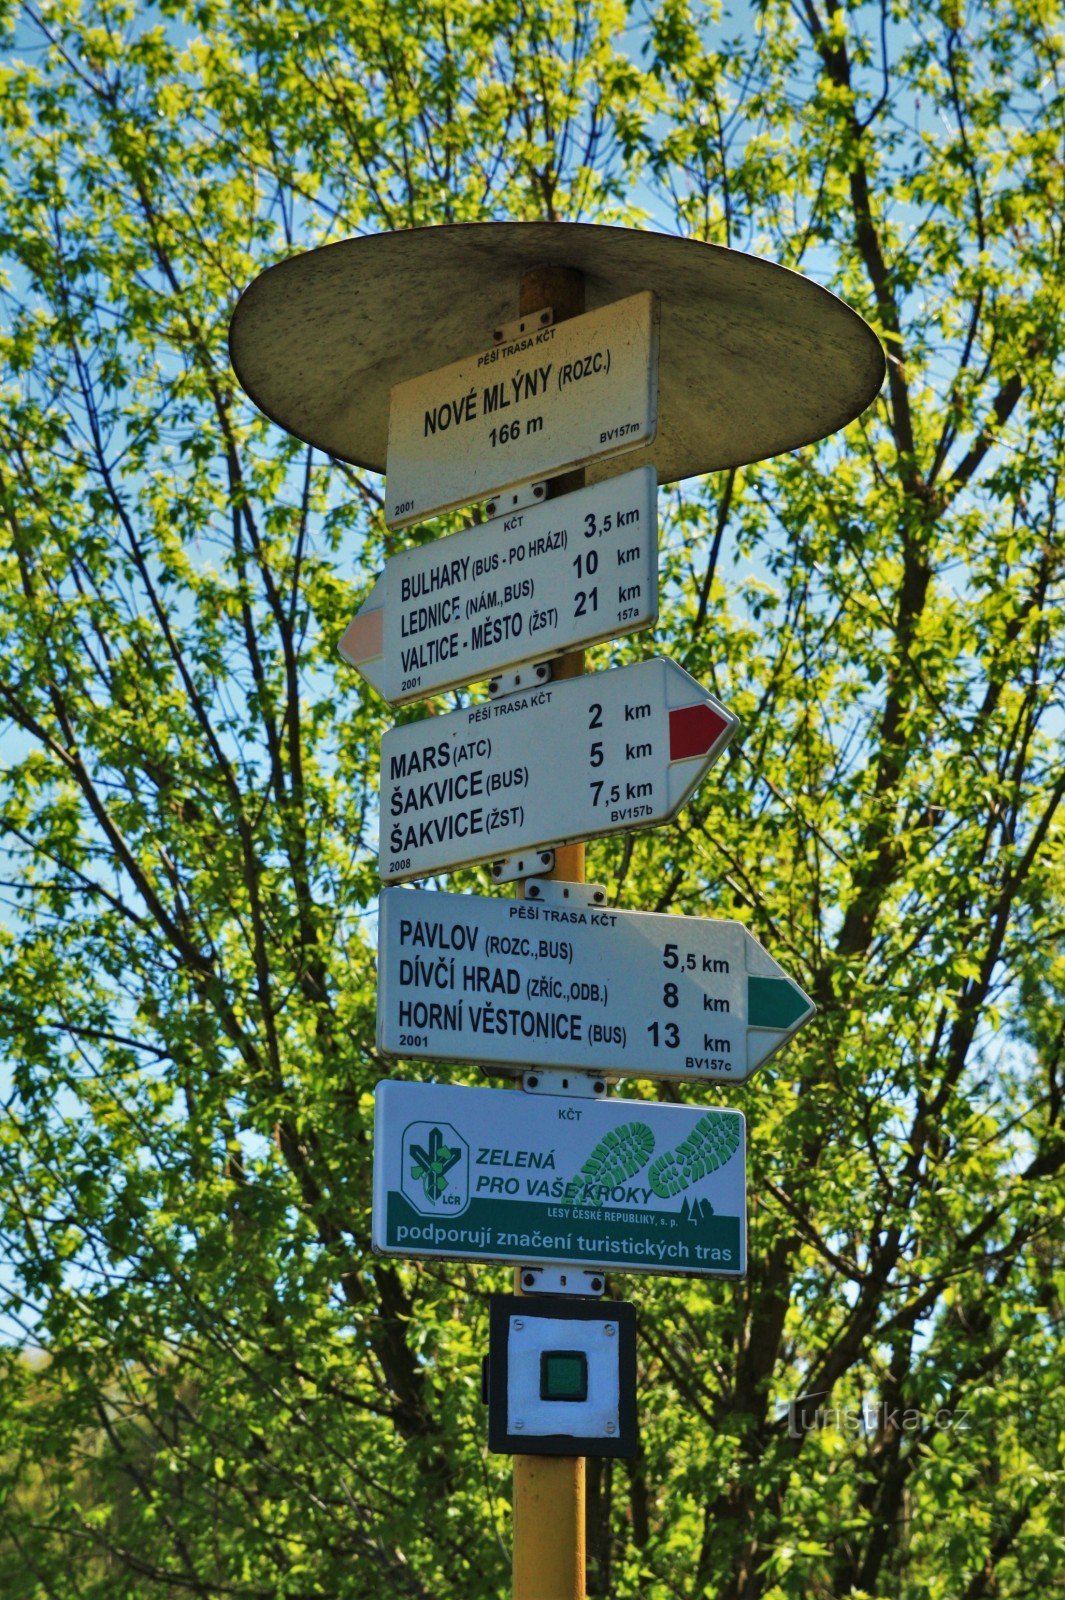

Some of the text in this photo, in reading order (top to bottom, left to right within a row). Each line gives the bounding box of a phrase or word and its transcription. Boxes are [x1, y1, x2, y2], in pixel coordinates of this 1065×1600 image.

[478, 328, 556, 367] PĚŠÍ TRASA KČT
[424, 349, 611, 437] NOVÉ MLÝNY (ROZC.)
[489, 416, 543, 447] 166 m
[600, 422, 640, 443] BV157m
[394, 500, 414, 516] 2001
[504, 516, 524, 533] KČT
[401, 556, 470, 602] BULHARY
[472, 553, 499, 579] (BUS
[509, 544, 526, 565] PO
[529, 529, 568, 559] HRÁZI)
[584, 513, 612, 538] 3,5
[616, 508, 640, 528] km
[573, 550, 598, 579] 10
[617, 546, 640, 566] km
[401, 633, 459, 673] VALTICE
[472, 612, 522, 650] MĚSTO
[528, 608, 558, 636] (ŽST)
[574, 587, 598, 618] 21
[618, 584, 641, 603] km
[617, 607, 639, 622] 157a
[401, 676, 421, 692] 2001
[468, 692, 553, 724] PĚŠÍ TRASA KČT
[390, 704, 651, 780] MARS (ATC) 2 km
[390, 742, 652, 816] ŠAKVICE (BUS) 5 km
[390, 781, 653, 854] ŠAKVICE (ŽST) 7,5 km
[611, 806, 653, 822] BV157b
[389, 859, 411, 873] 2008
[509, 906, 617, 927] PĚŠÍ TRASA KČT
[400, 920, 729, 974] PAVLOV (ROZC.,BUS) 5,5 km
[400, 954, 730, 1013] DÍVČÍ HRAD (ZŘÍC.,ODB.) 8 km
[399, 999, 731, 1053] HORNÍ VĚSTONICE (BUS) 13 km
[400, 1034, 428, 1047] 2001
[685, 1057, 732, 1072] BV157c
[558, 1108, 582, 1121] KČT
[476, 1148, 556, 1170] ZELENÁ
[442, 1194, 460, 1206] LČR
[476, 1176, 653, 1204] PRO VAŠE KROKY
[548, 1207, 678, 1227] LESY ČESKÉ REPUBLIKY, s. p.
[397, 1223, 732, 1261] podporují značení turistických tras
